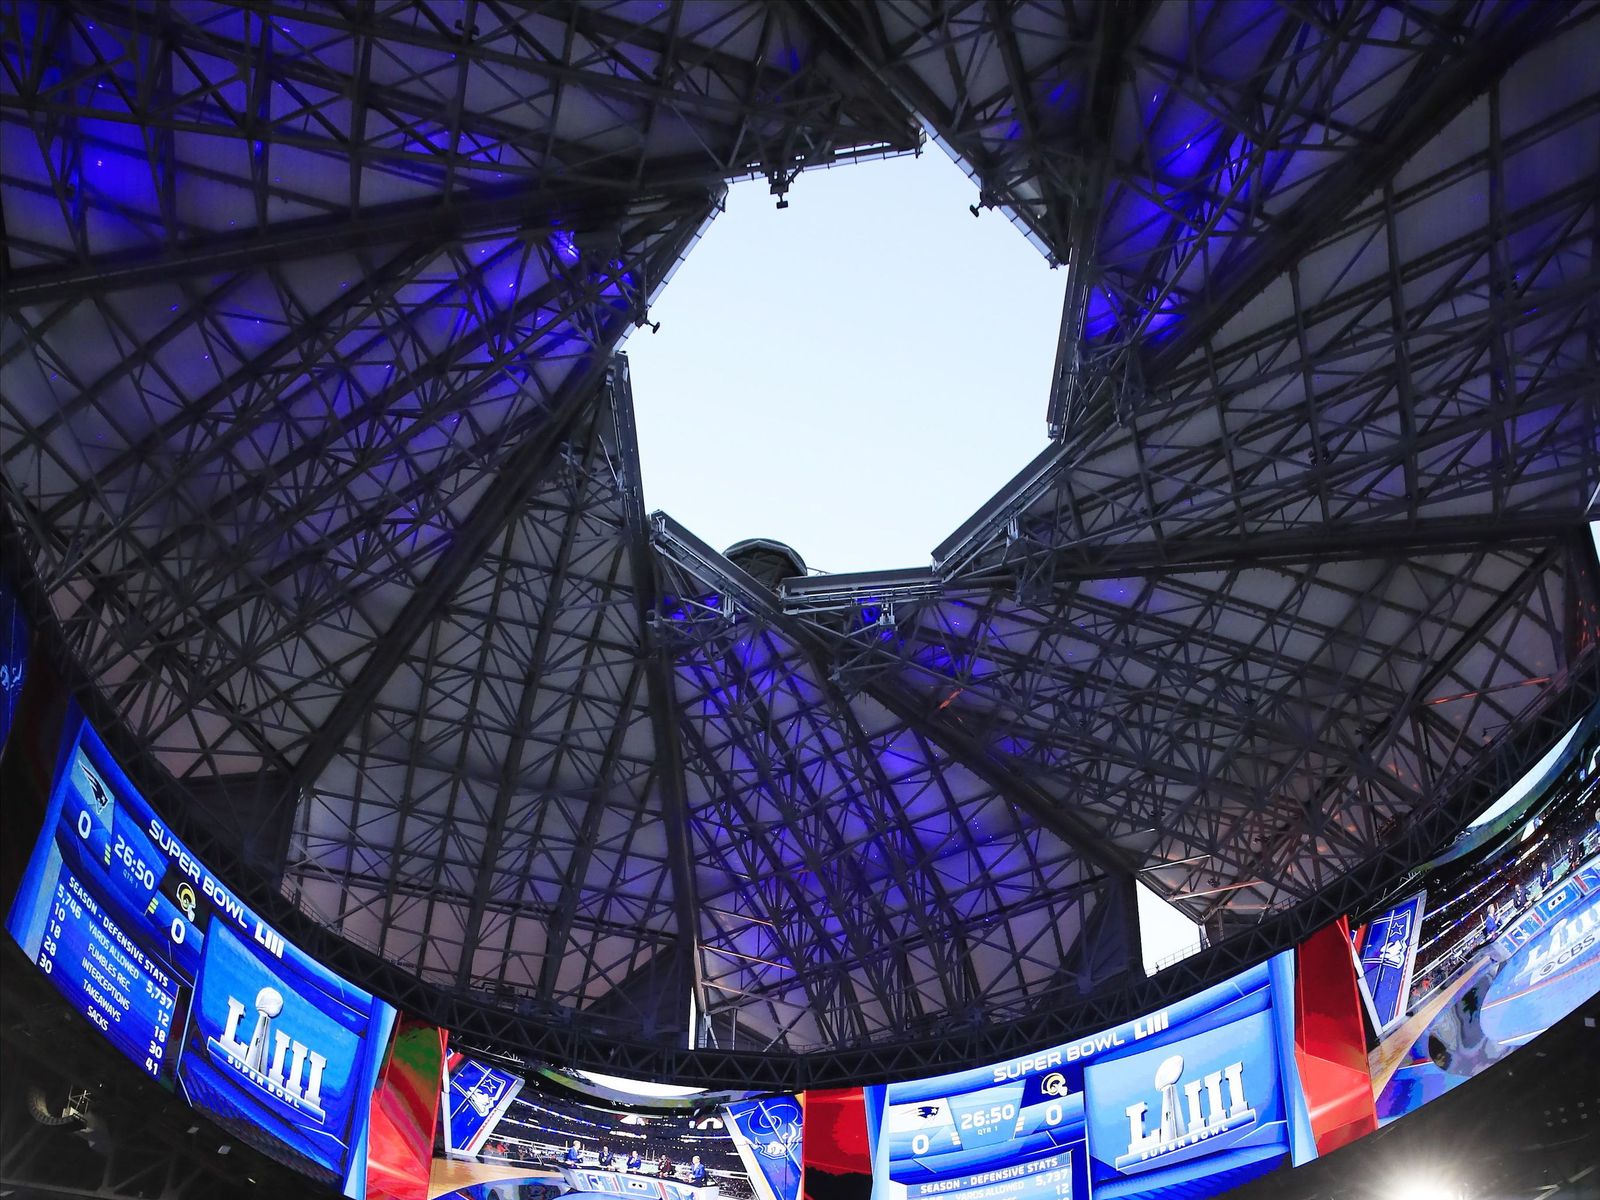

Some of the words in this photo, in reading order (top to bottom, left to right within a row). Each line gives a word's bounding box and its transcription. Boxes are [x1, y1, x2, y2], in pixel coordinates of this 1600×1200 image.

[78, 810, 92, 839] 0
[114, 834, 154, 890] 26:50
[149, 819, 201, 884] SUPER
[203, 877, 247, 929] BOWL
[254, 921, 285, 959] LIII
[57, 885, 81, 919] 5,746
[88, 921, 110, 950] YARDS
[109, 946, 139, 980] ALLOWED
[146, 981, 173, 1010] 5,737
[68, 876, 98, 916] SEASON
[103, 916, 143, 963] DEFENSIVE
[145, 960, 168, 987] STATS
[171, 918, 185, 944] 0
[1557, 934, 1595, 964] CBS
[50, 920, 61, 939] 18
[81, 957, 130, 1010] INTERCEPTIONS
[154, 1025, 166, 1042] 18
[54, 903, 66, 922] 10
[88, 943, 116, 977] FUMBLES
[117, 973, 131, 992] REC.
[158, 1010, 168, 1027] 12
[39, 953, 52, 974] 30
[87, 1005, 109, 1031] SACKS
[145, 1057, 159, 1075] 41
[43, 935, 57, 956] 28
[83, 979, 121, 1022] TAKEAWAYS
[149, 1040, 162, 1058] 30
[992, 1052, 1062, 1083] SUPER
[1066, 1033, 1125, 1062] BOWL
[1133, 1010, 1169, 1041] LIII
[227, 1055, 264, 1086] SUPER
[267, 1084, 300, 1109] BOWL
[961, 1103, 1015, 1130] 26:50
[977, 1127, 992, 1136] QTR
[1045, 1104, 1063, 1125] 0
[912, 1134, 930, 1155] 0
[1141, 1141, 1185, 1160] SUPER
[1191, 1125, 1229, 1144] BOWL
[920, 1178, 960, 1194] SEASON
[970, 1167, 1025, 1186] DEFENSIVE
[1027, 1158, 1058, 1173] STATS
[955, 1189, 985, 1200] YARDS
[986, 1181, 1025, 1197] ALLOWED
[1035, 1169, 1068, 1187] 5,737
[1055, 1184, 1069, 1195] 12
